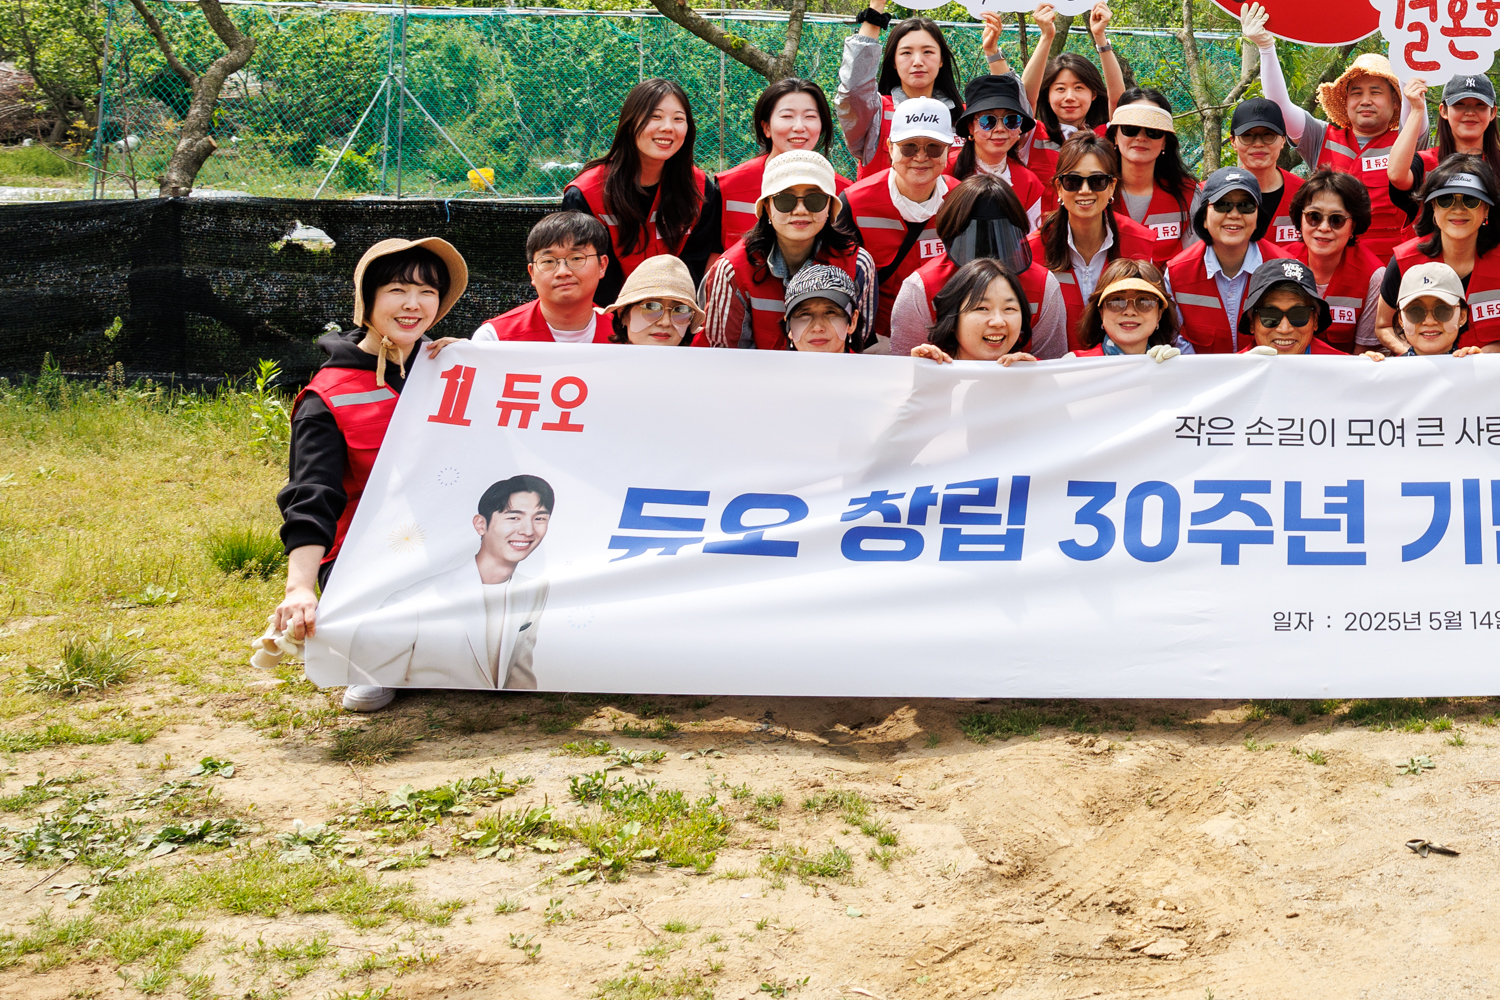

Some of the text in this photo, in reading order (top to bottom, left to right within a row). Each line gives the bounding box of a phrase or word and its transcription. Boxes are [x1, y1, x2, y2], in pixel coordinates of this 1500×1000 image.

[905, 113, 940, 124] Volvik
[1375, 158, 1388, 168] 듀오
[1162, 226, 1178, 237] 듀오
[1339, 310, 1353, 321] 듀오
[496, 374, 588, 432] 듀오
[1175, 416, 1235, 446] 작은
[1246, 417, 1334, 447] 손길이
[1347, 418, 1405, 447] 모여
[1416, 418, 1445, 446] 큰
[608, 488, 808, 561] 듀오
[841, 476, 1030, 561] 창립
[1059, 480, 1366, 565] 30주년
[1274, 611, 1314, 632] 일자
[1344, 611, 1421, 632] 2025년
[1429, 610, 1462, 631] 5월
